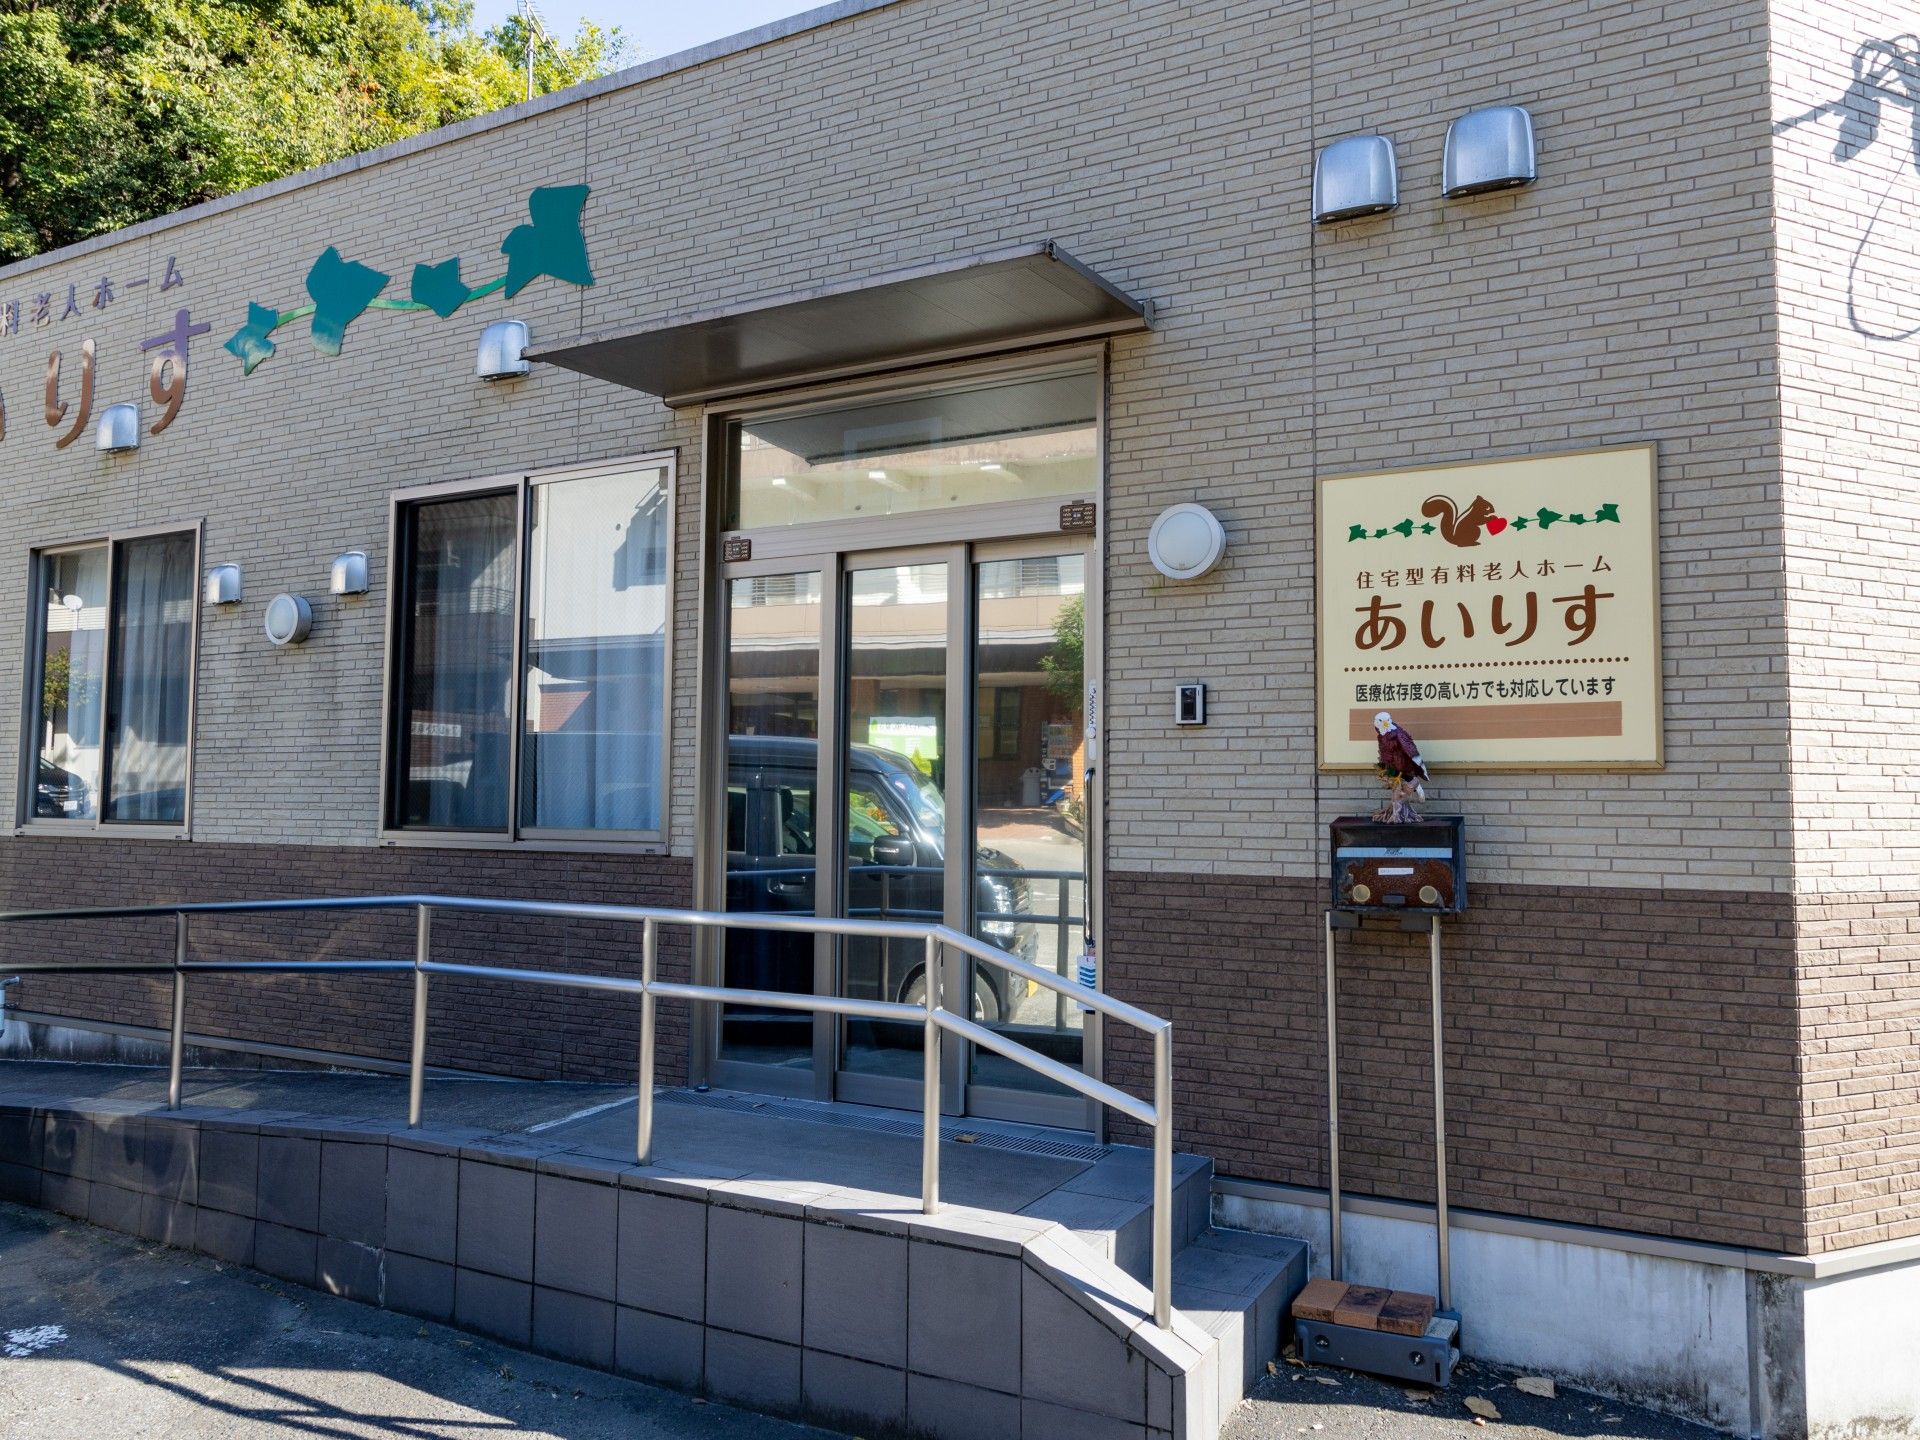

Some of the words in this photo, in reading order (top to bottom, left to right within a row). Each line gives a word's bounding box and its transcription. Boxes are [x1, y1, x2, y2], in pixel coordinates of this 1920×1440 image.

[0, 308, 211, 449] りす
[1356, 555, 1612, 590] 住宅型有料老人ホーム
[1355, 584, 1615, 651] あいりす
[1355, 676, 1616, 703] 医療依存度の高い方でも対応しています
